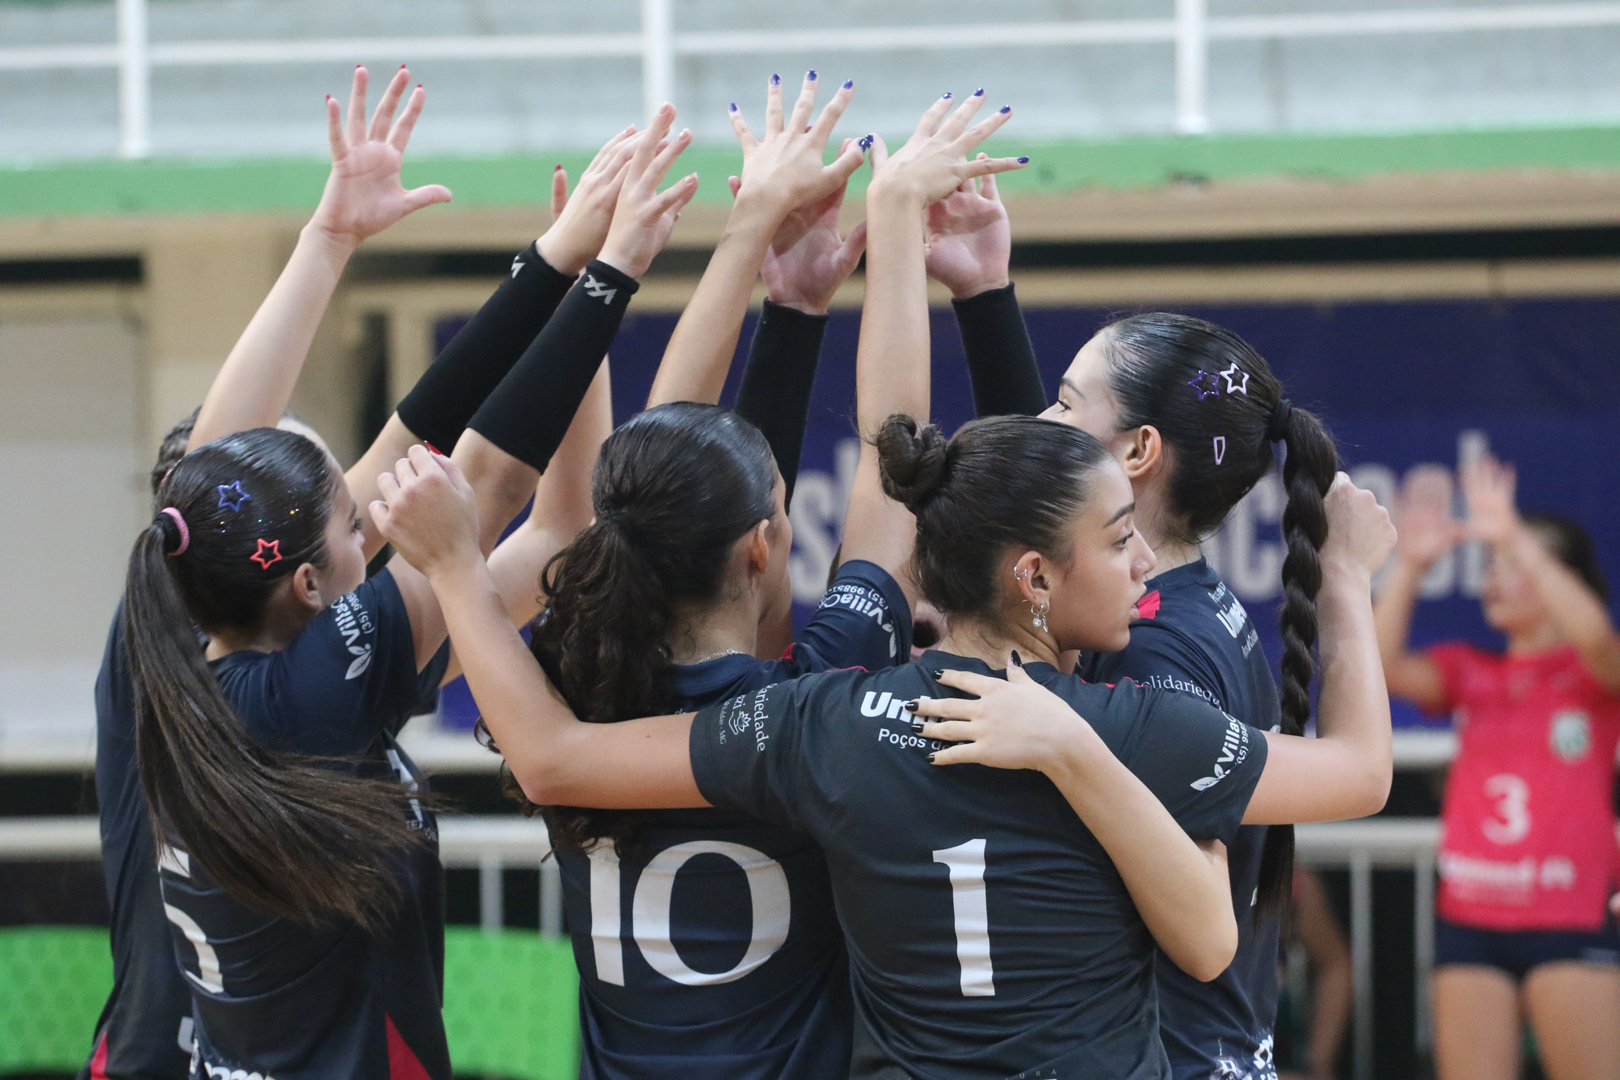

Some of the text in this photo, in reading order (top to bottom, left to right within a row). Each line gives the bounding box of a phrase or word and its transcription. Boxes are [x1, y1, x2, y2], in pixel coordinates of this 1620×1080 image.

[357, 610, 375, 634] (35)
[753, 683, 778, 752] ariedade
[878, 727, 927, 749] Poços
[1480, 772, 1533, 846] 3
[586, 837, 791, 987] 10
[932, 838, 995, 997] 1
